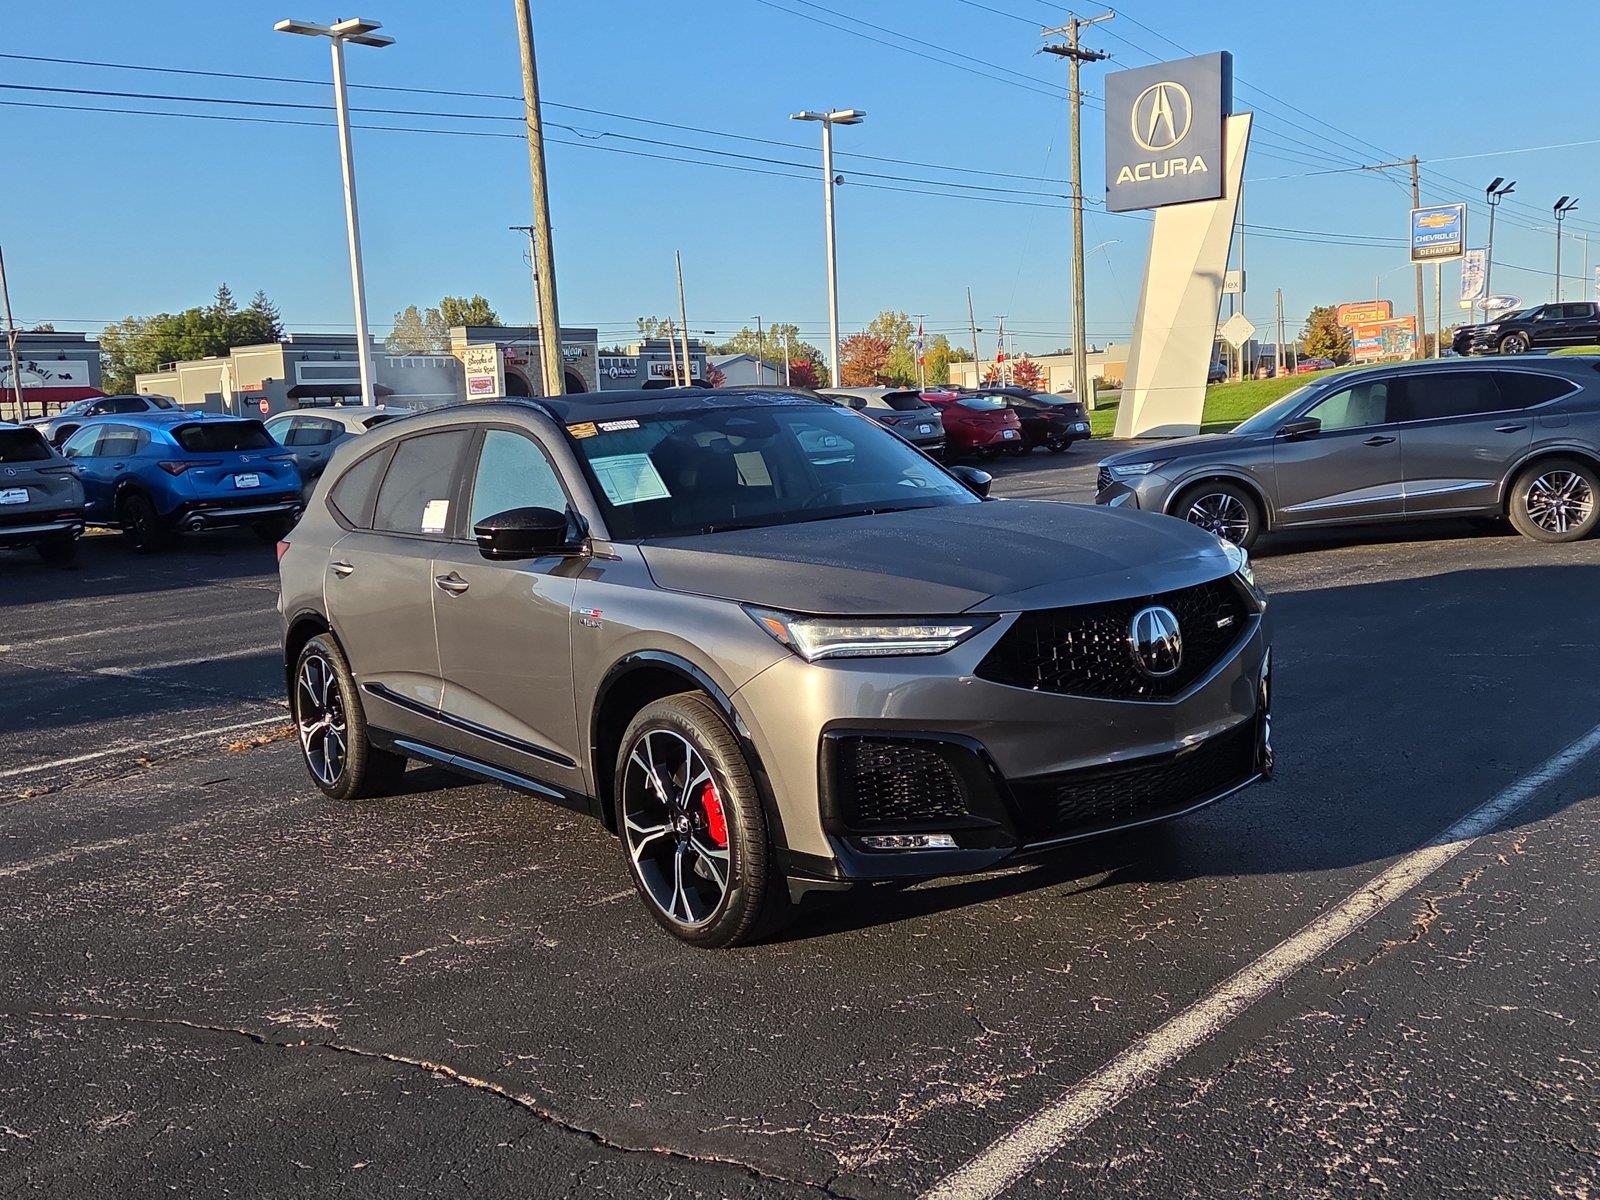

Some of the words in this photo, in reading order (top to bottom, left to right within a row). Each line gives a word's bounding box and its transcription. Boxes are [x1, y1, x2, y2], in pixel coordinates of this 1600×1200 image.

[1116, 155, 1208, 184] ACURA
[1415, 231, 1459, 243] CHEVROLET
[1420, 246, 1454, 255] DEHAVEN
[1225, 281, 1239, 289] lex
[657, 364, 697, 374] FIREOE
